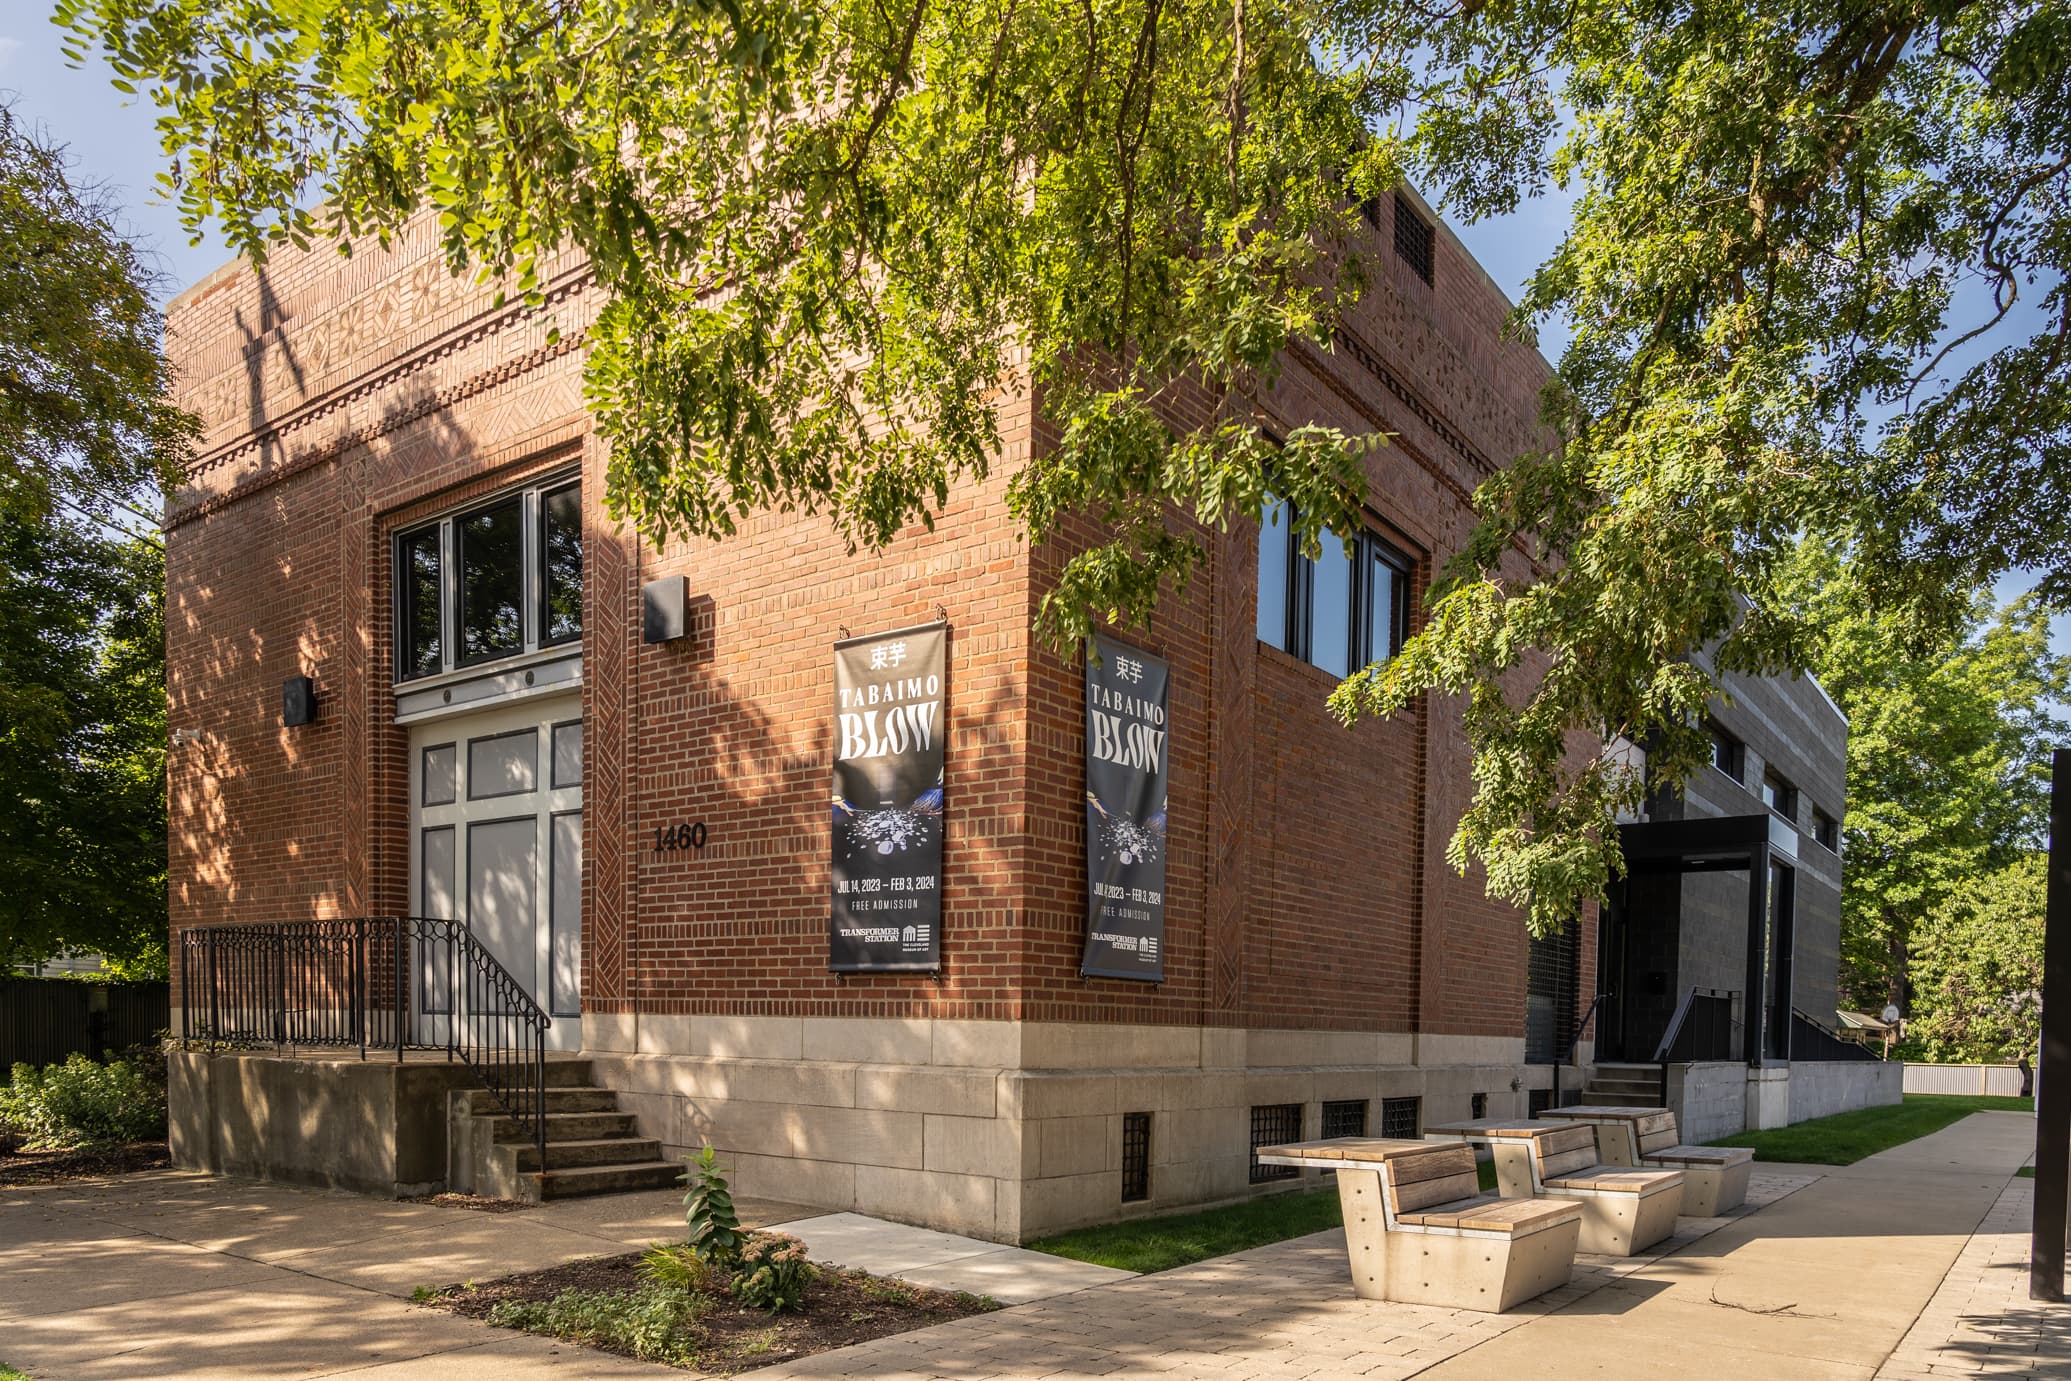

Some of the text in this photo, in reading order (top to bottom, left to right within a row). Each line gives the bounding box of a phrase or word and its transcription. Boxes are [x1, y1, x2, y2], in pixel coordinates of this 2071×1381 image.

[870, 641, 907, 670] 束芋
[1116, 655, 1143, 684] 束芋
[840, 674, 939, 709] TABAIMO
[1091, 683, 1165, 725] TABAIMO
[838, 700, 940, 760] BLOW
[1091, 709, 1165, 775] BLOW
[654, 822, 707, 851] 1460
[838, 880, 850, 894] JUL
[851, 880, 861, 894] 14,
[861, 878, 881, 892] 2023
[890, 877, 905, 891] FEB
[906, 877, 914, 892] 3,
[915, 875, 935, 890] 2024
[1108, 885, 1125, 900] 2023
[1132, 888, 1142, 902] FEB
[1148, 891, 1161, 905] 2024
[851, 898, 918, 911] FREE ADMISSION
[840, 927, 900, 937] TRANSFORMER
[864, 934, 899, 943] STATION
[1091, 932, 1138, 944] TRANSFORMER
[1112, 941, 1138, 951] STATION
